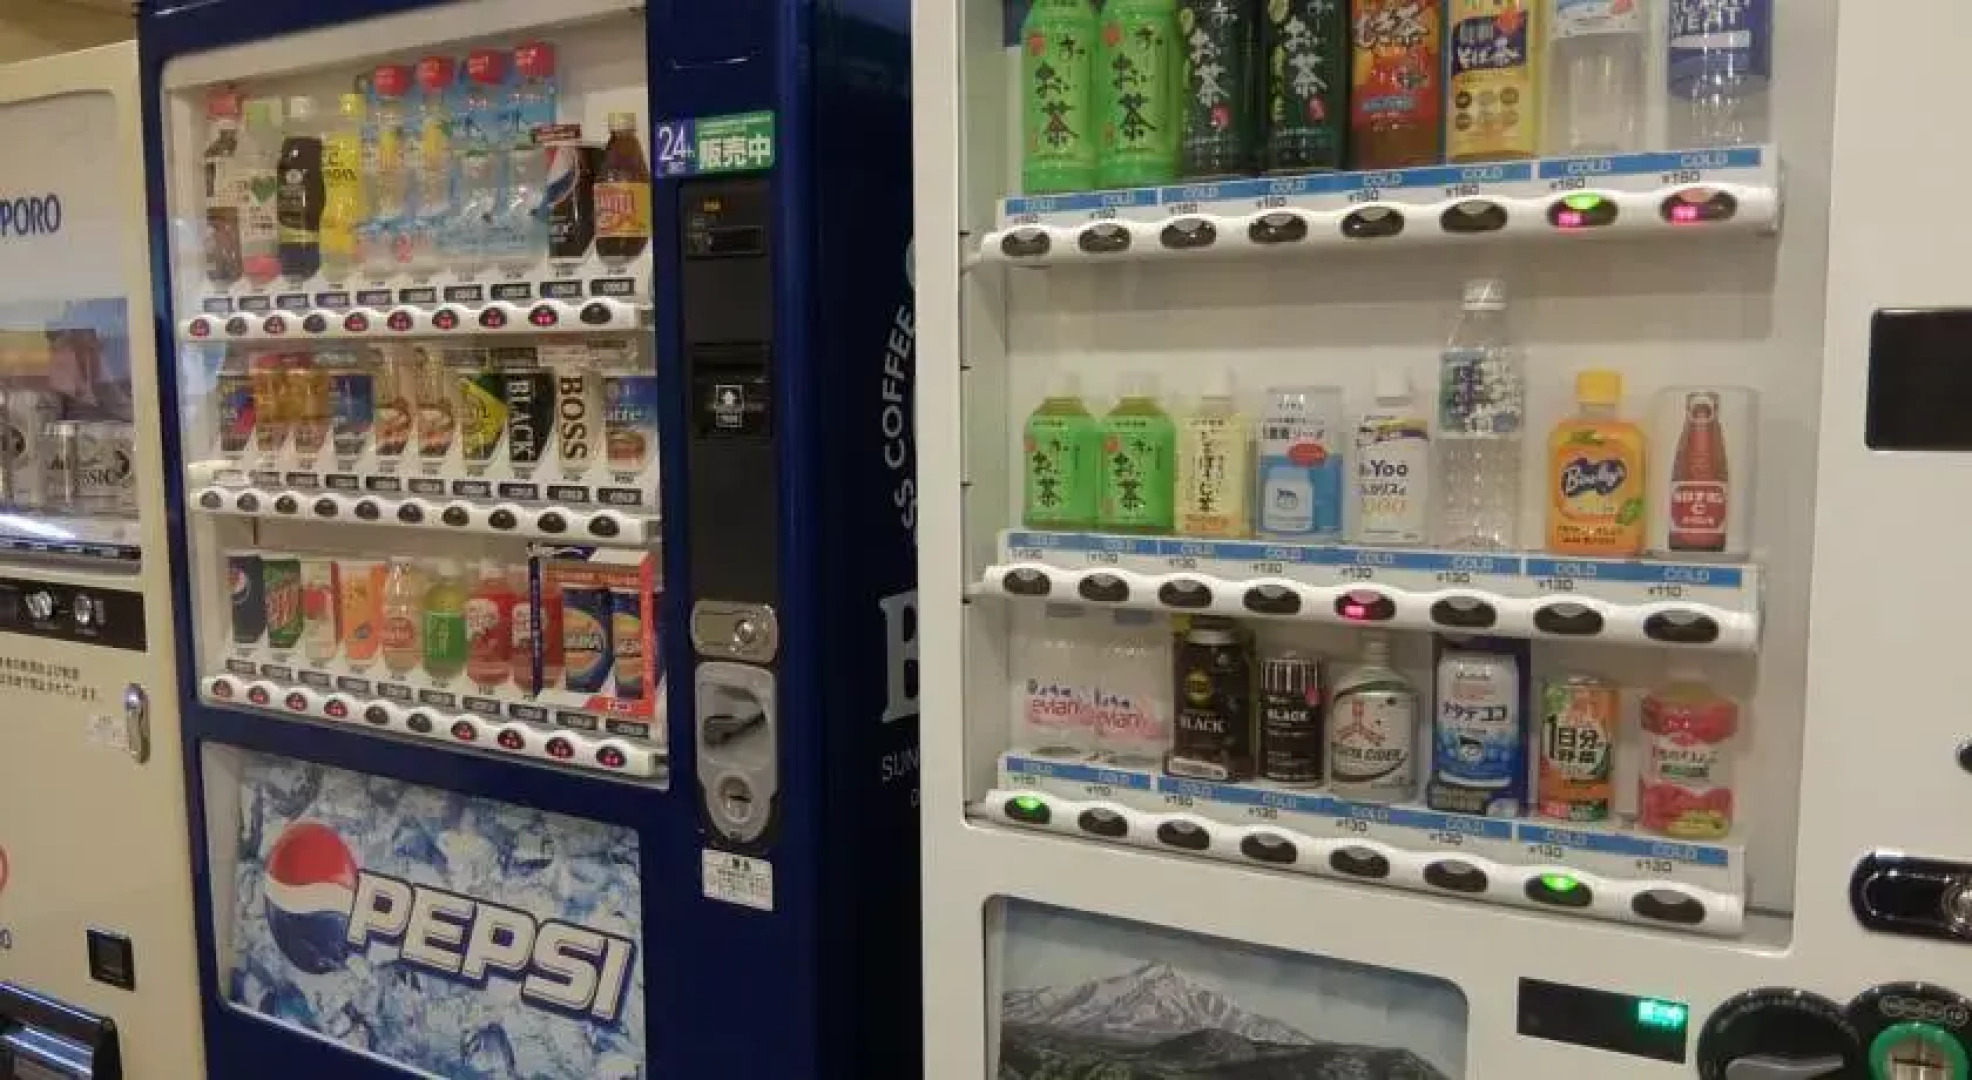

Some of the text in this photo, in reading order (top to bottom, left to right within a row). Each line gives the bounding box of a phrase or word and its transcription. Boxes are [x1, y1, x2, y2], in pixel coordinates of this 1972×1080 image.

[699, 133, 771, 170] 販売中
[507, 379, 535, 463] BLACK
[560, 376, 588, 460] BOSS
[881, 304, 915, 469] COFFEE
[1180, 715, 1226, 733] BLACK
[1267, 709, 1308, 722] BLACK
[347, 869, 636, 1023] PEPSI
